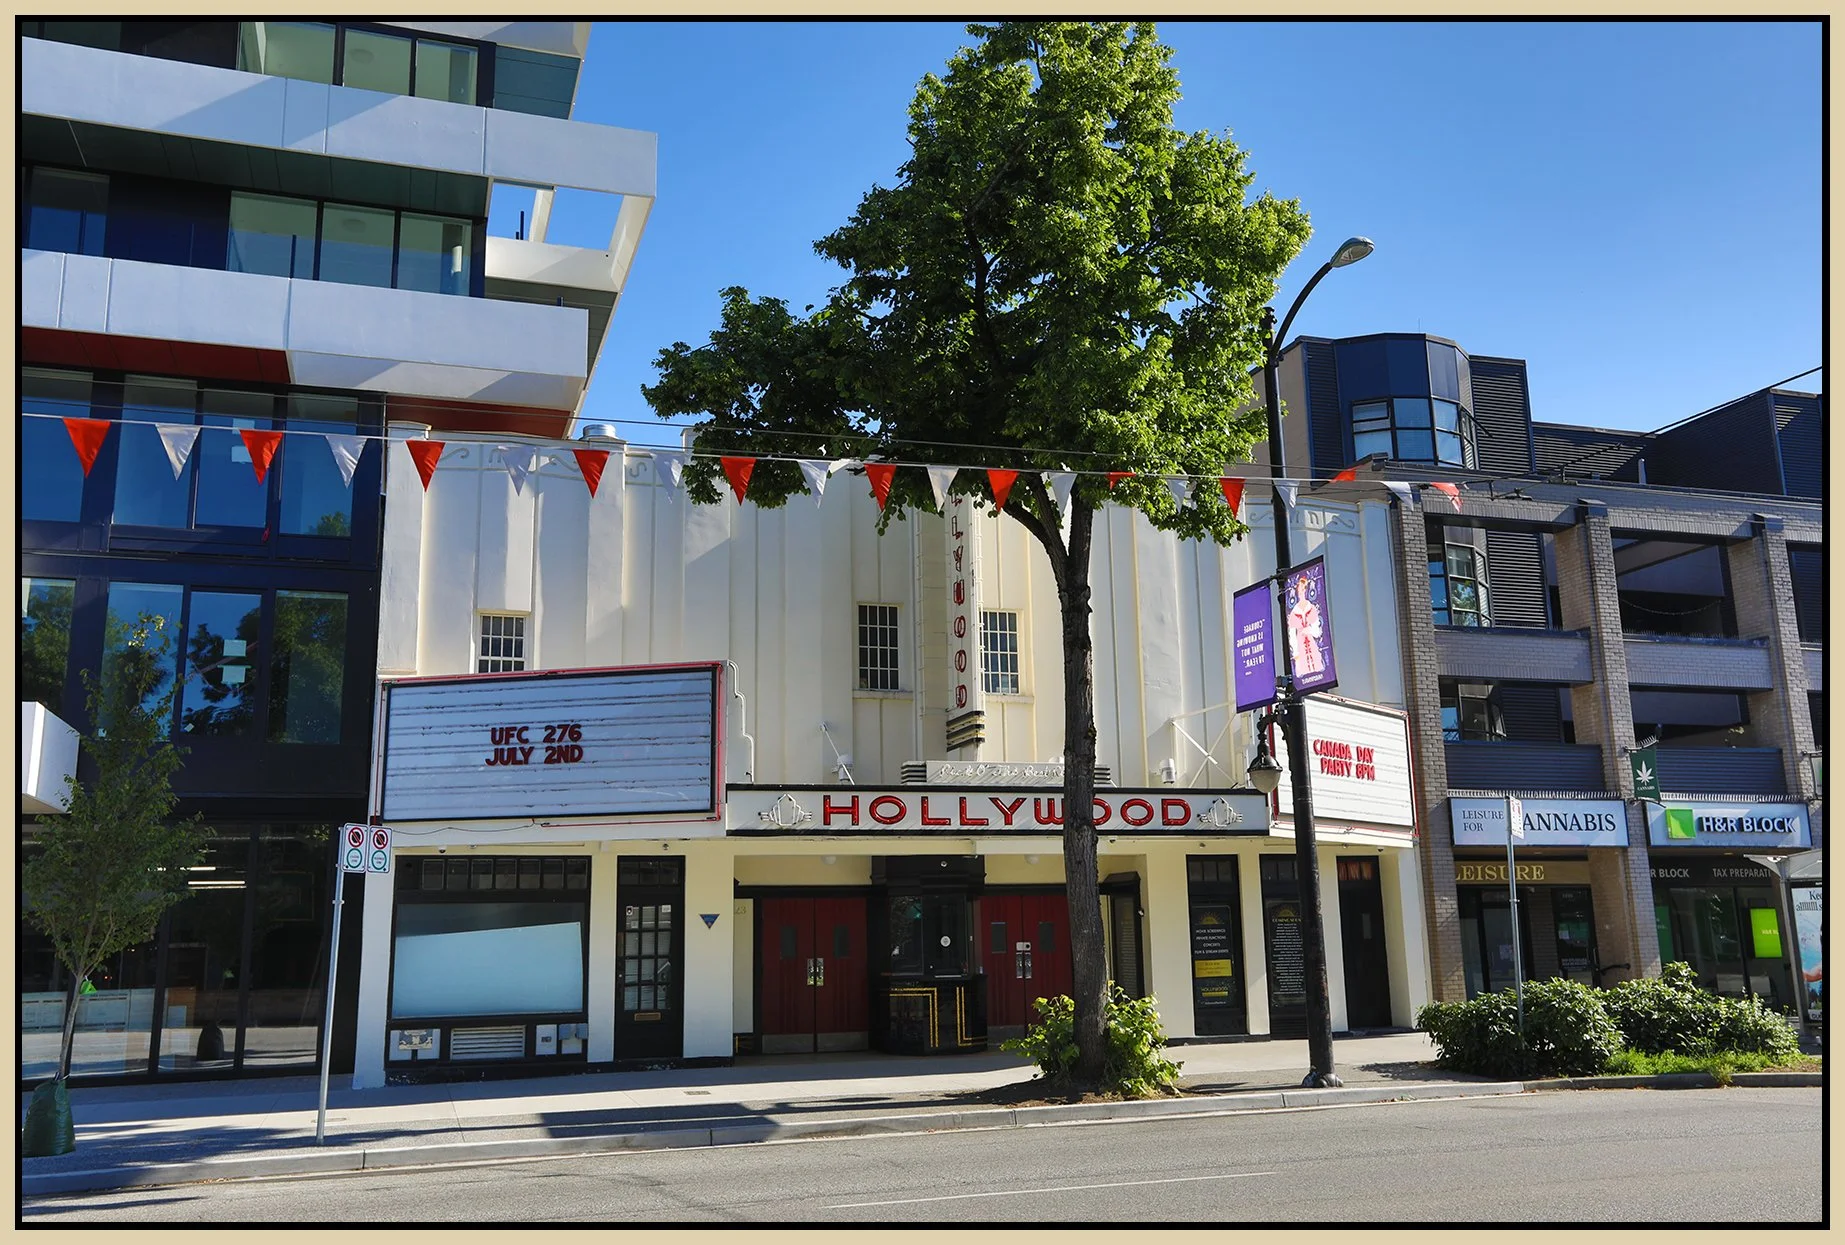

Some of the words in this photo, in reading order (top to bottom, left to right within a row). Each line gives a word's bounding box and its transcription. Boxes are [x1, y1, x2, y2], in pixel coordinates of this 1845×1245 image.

[951, 492, 968, 709] LLYWOOD
[491, 726, 529, 745] UFC
[543, 724, 582, 743] 276
[485, 746, 535, 766] JULY
[544, 744, 583, 764] 2ND
[1313, 739, 1352, 760] CANADA
[1356, 746, 1374, 764] DAY
[1320, 757, 1352, 778] PARTY
[1356, 763, 1375, 781] 8PM
[823, 795, 1192, 826] HOLLYWOOD
[1462, 810, 1504, 820] LEISURE
[1463, 822, 1484, 832] FOR
[1523, 813, 1616, 832] ANNABIS
[1702, 816, 1736, 832] H&R
[1742, 816, 1797, 833] BLOCK
[1659, 868, 1690, 878] BLOCK
[1712, 867, 1727, 878] TAX
[1730, 868, 1771, 878] PREPARATI
